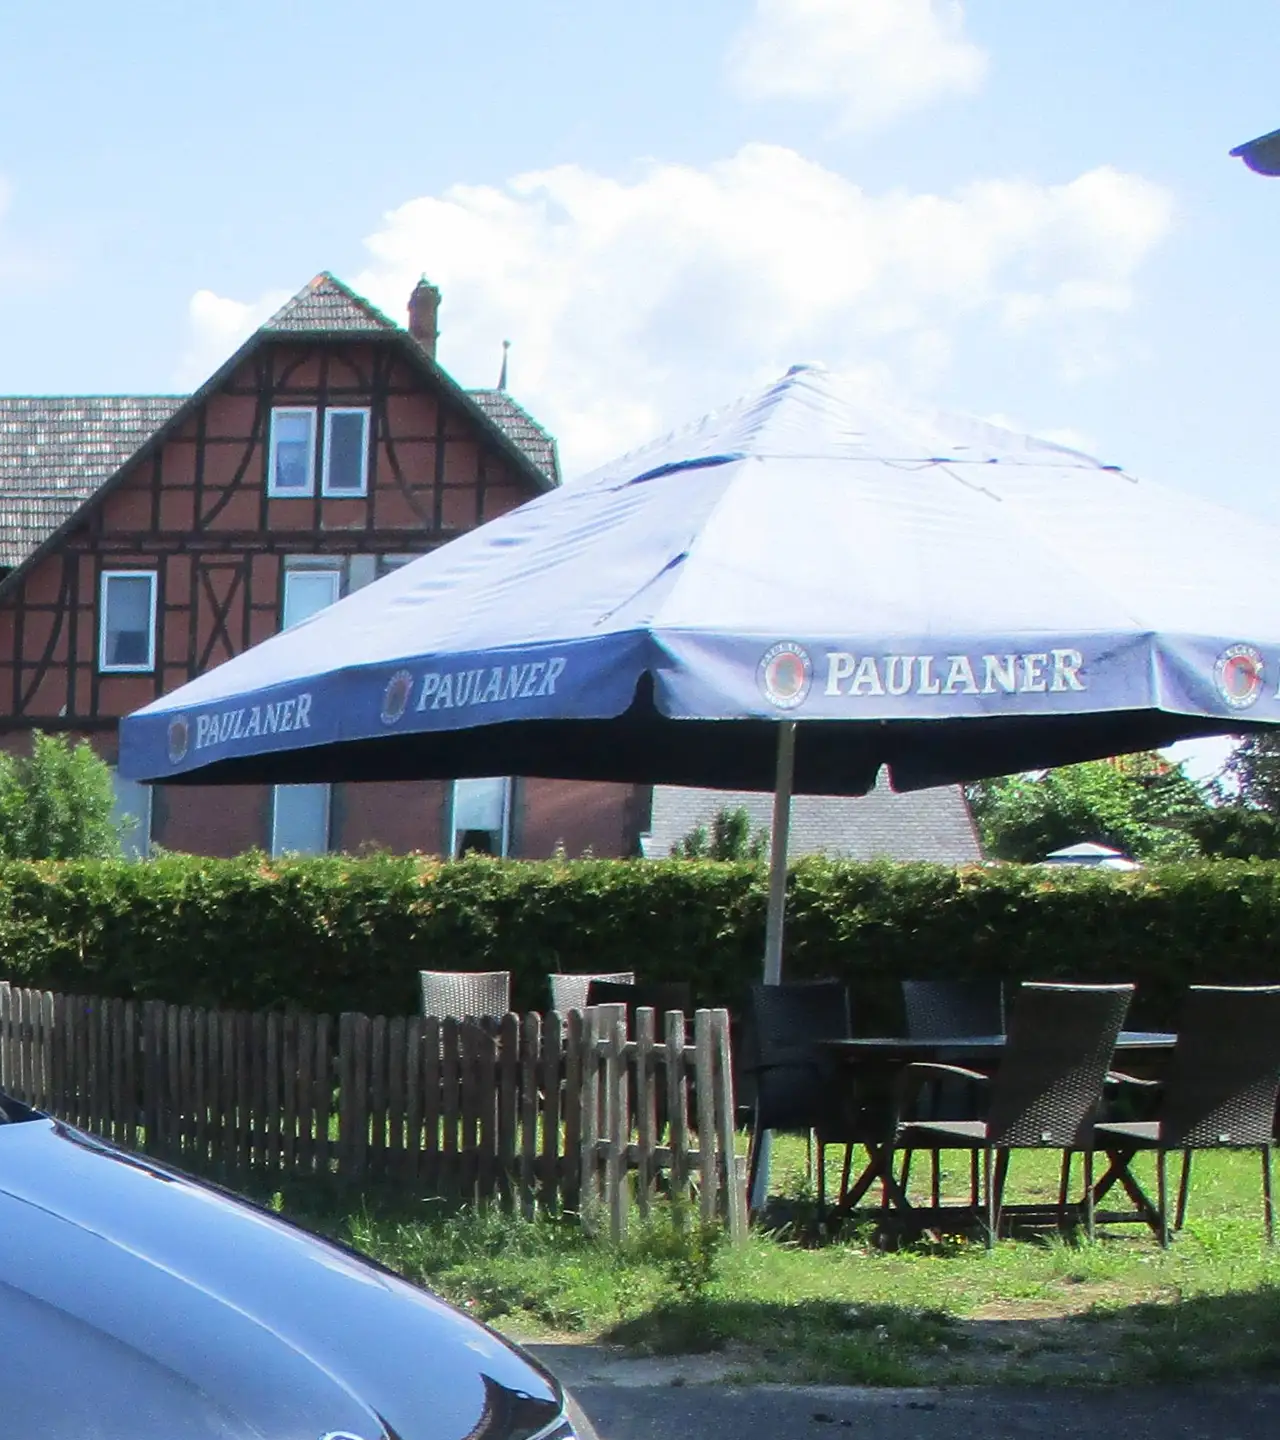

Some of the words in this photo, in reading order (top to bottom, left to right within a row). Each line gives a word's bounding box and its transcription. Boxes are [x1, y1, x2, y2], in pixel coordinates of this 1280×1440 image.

[415, 657, 568, 712] PAULANER
[824, 648, 1087, 697] PAULANER
[194, 692, 312, 750] PAULANER
